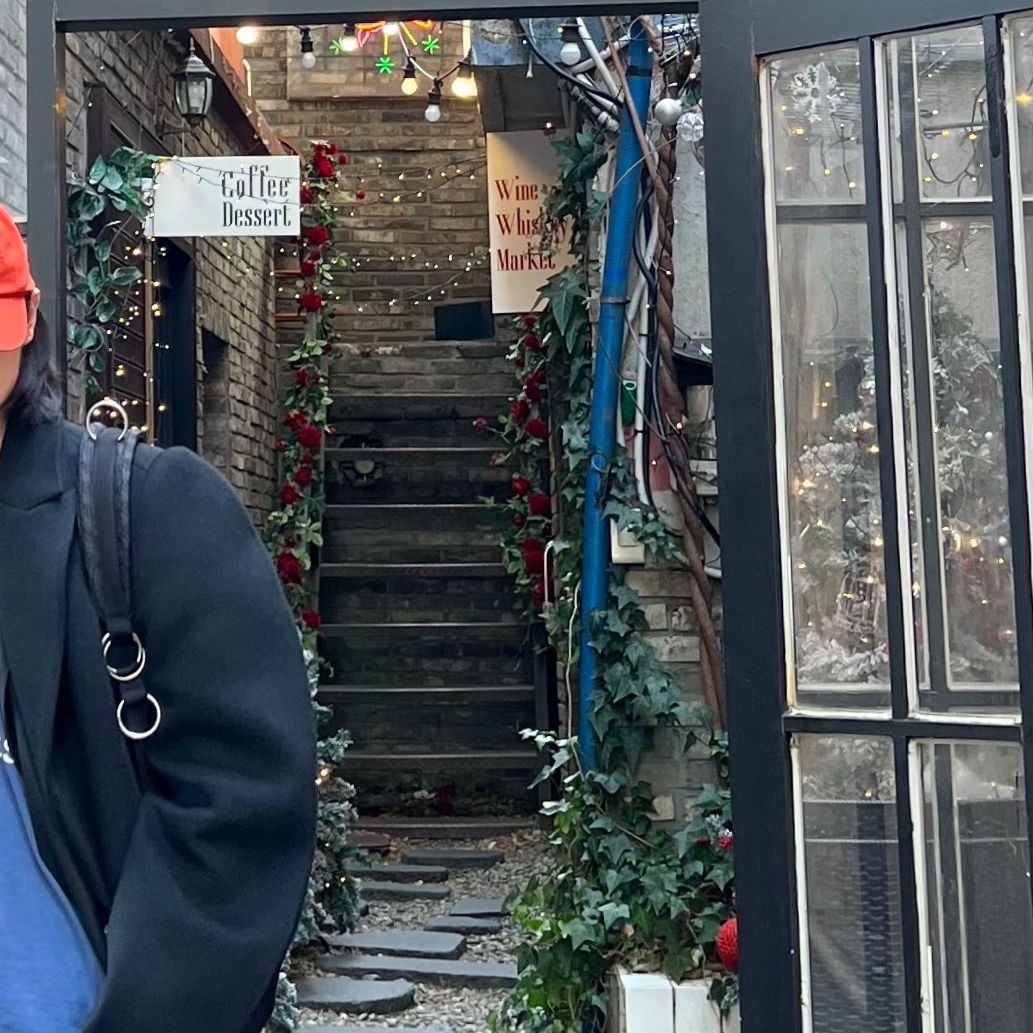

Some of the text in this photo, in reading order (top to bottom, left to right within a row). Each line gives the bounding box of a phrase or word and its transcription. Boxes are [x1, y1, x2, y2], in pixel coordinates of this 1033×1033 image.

[221, 165, 290, 198] Coffee
[494, 175, 539, 201] Wine
[222, 201, 292, 227] Dessert
